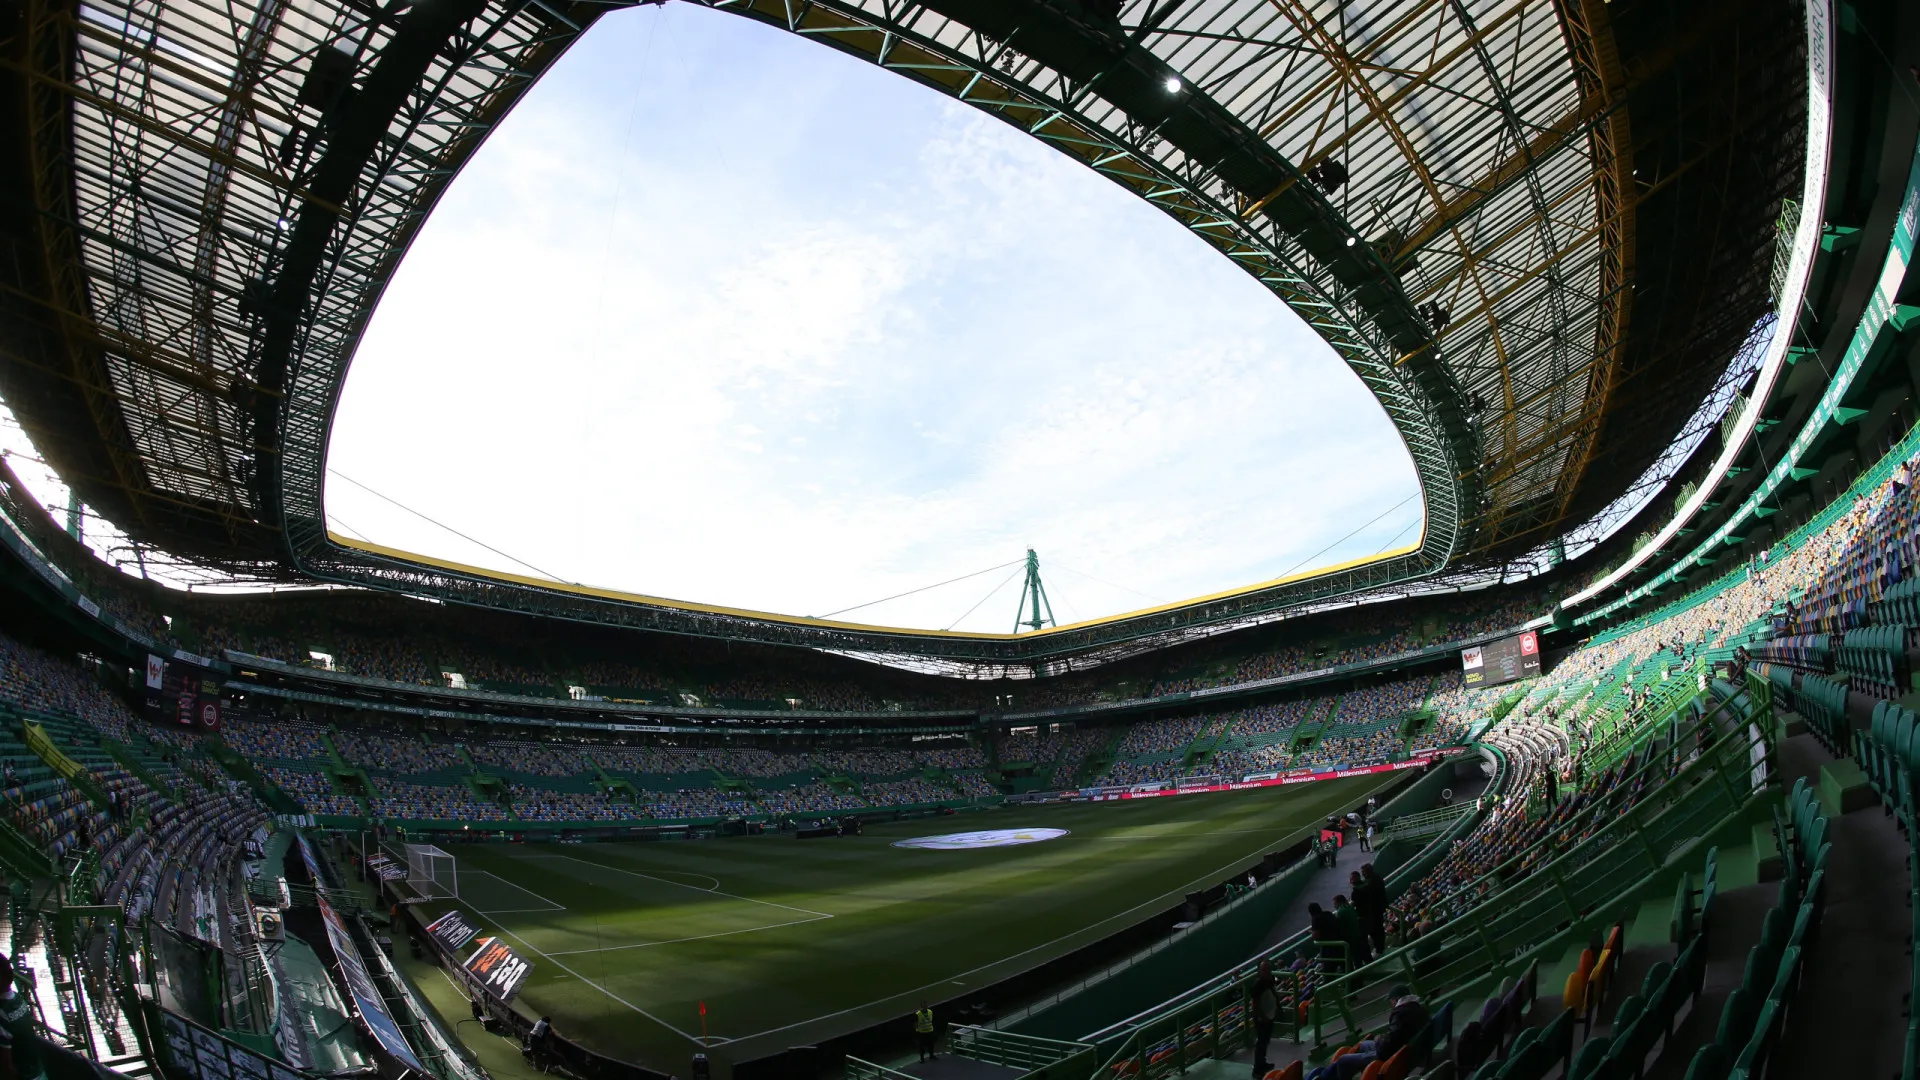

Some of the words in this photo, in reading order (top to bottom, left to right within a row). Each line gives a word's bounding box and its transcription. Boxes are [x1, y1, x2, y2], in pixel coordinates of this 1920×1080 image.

[1372, 655, 1399, 665] MEDALHAS
[1393, 758, 1428, 771] Millennium
[1336, 767, 1373, 779] Millennium
[1282, 774, 1317, 786] Millennium
[1229, 781, 1263, 791] Millennium
[1131, 791, 1161, 800] Millennium
[1179, 788, 1211, 796] Millennium
